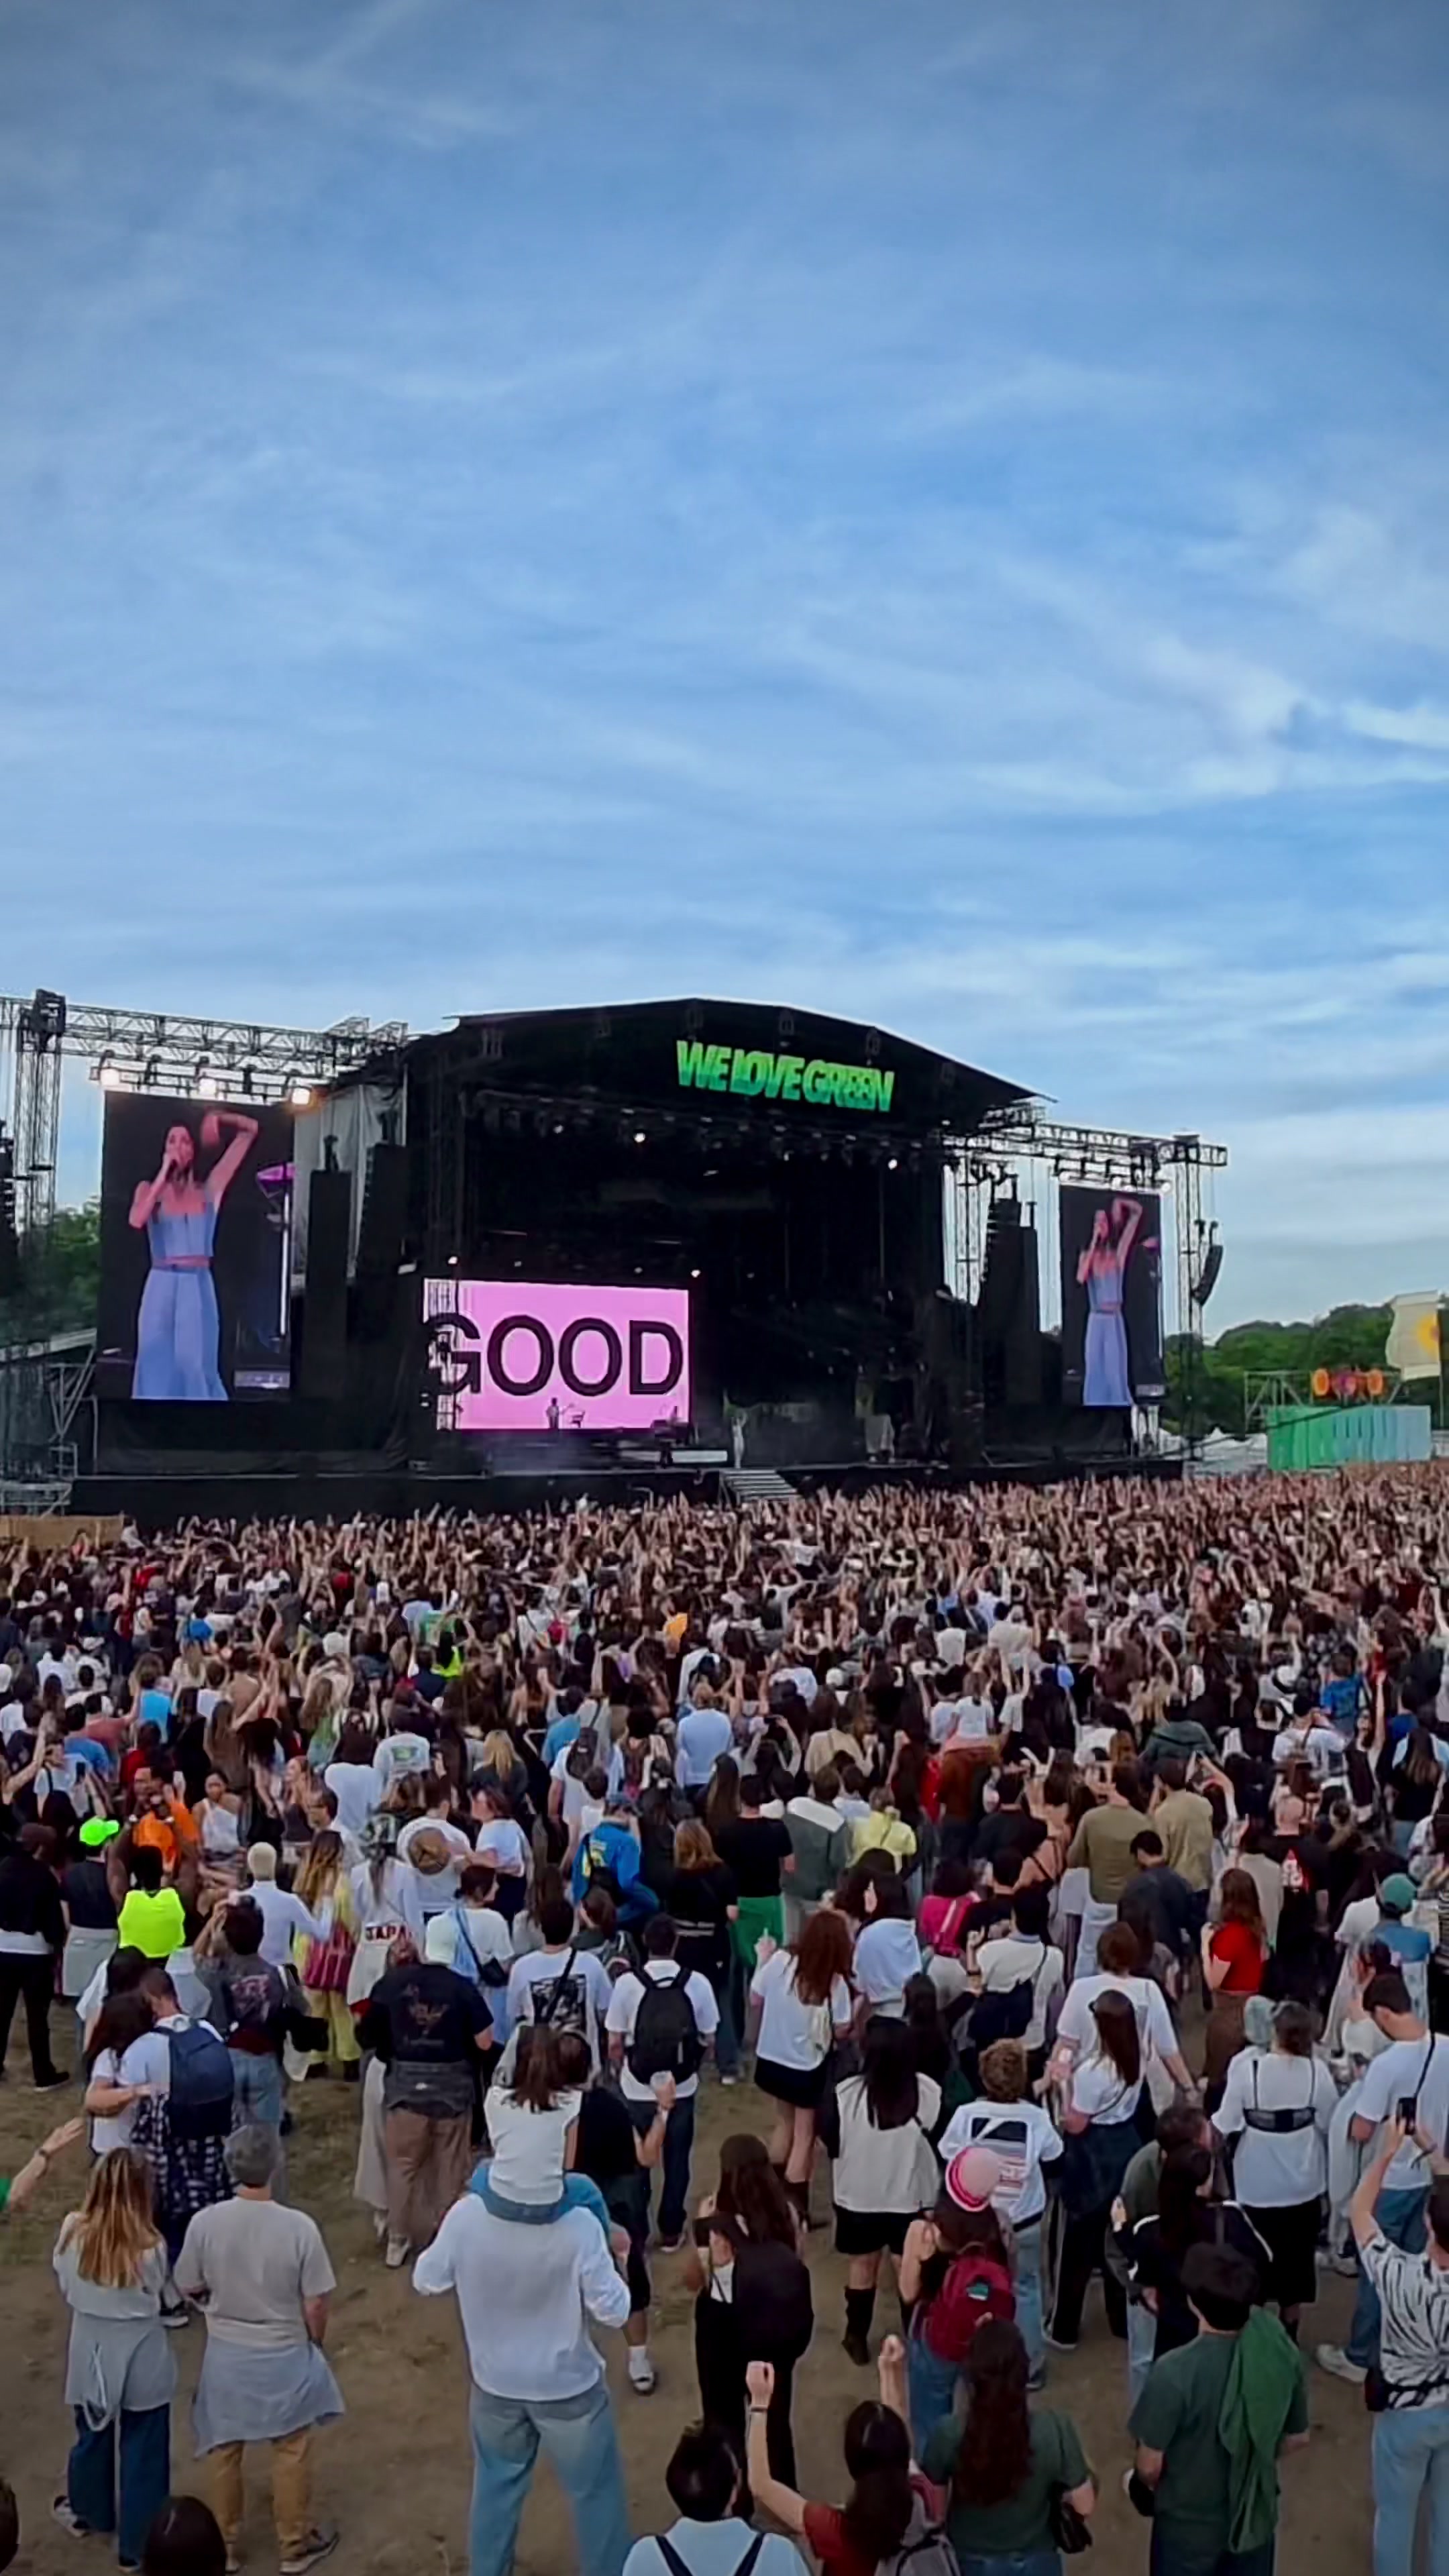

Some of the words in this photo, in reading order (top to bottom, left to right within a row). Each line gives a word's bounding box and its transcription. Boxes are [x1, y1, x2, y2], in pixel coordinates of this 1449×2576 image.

[676, 1040, 732, 1091] WE
[729, 1049, 805, 1101] LOVE
[803, 1059, 896, 1112] GREEN
[425, 1313, 684, 1397] GOOD
